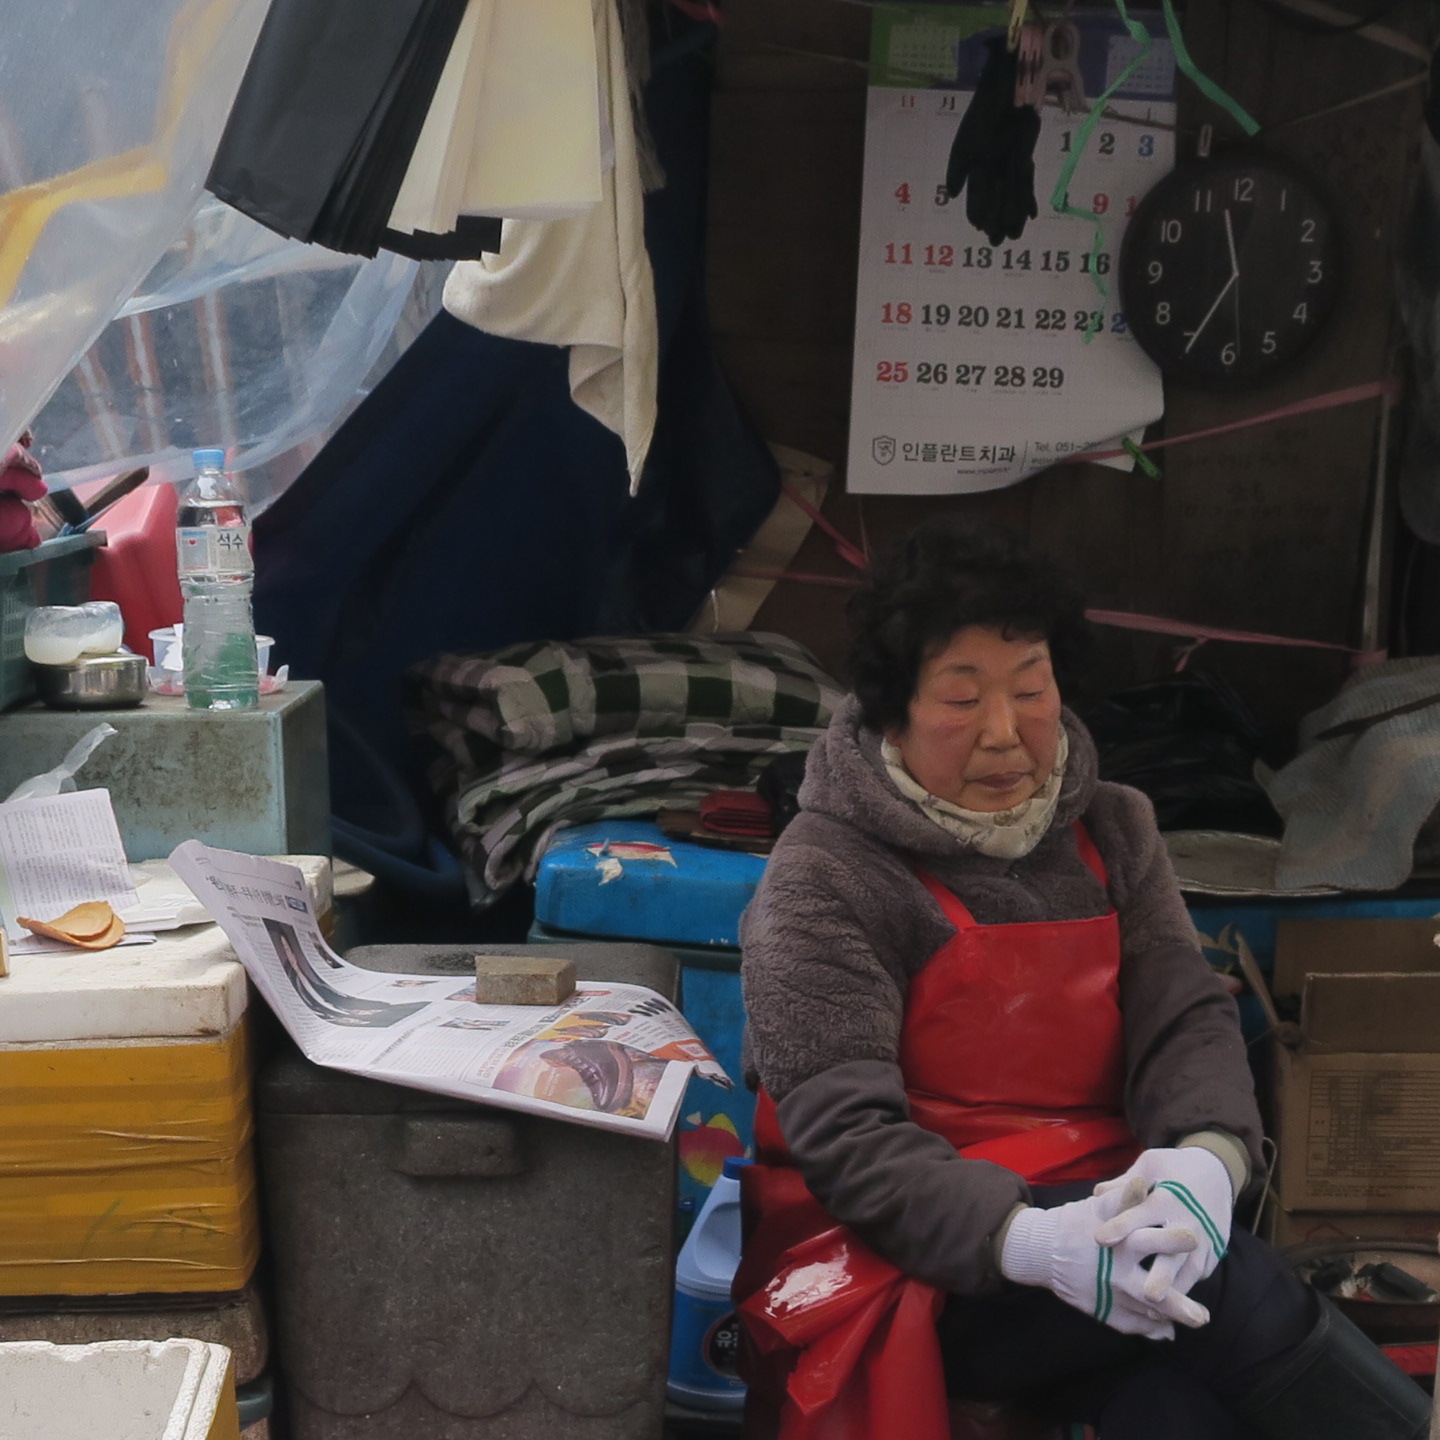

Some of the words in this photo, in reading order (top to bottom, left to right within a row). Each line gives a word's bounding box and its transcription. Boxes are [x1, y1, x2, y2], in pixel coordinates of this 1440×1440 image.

[1061, 131, 1072, 153] 1
[1098, 133, 1115, 155] 2
[1138, 134, 1155, 157] 3
[894, 182, 911, 205] 4
[934, 184, 950, 206] 5
[1195, 189, 1212, 213] 11
[1234, 177, 1255, 202] 12
[1092, 192, 1109, 215] 9
[1160, 219, 1183, 244] 10
[1300, 218, 1316, 243] 2
[884, 243, 913, 265] 11
[924, 244, 954, 267] 12
[961, 246, 993, 269] 13
[1001, 248, 1032, 271] 14
[1039, 250, 1070, 273] 15
[1078, 252, 1110, 275] 16
[1147, 260, 1164, 285] 9
[1307, 260, 1323, 284] 3
[880, 302, 913, 325] 18
[921, 303, 951, 326] 19
[957, 305, 990, 328] 20
[996, 307, 1025, 330] 21
[1034, 309, 1067, 331] 22
[1073, 310, 1104, 333] 23
[1155, 301, 1172, 326] 8
[1292, 301, 1309, 325] 4
[1220, 342, 1236, 366] 6
[1261, 330, 1277, 355] 5
[875, 360, 909, 383] 25
[915, 362, 948, 385] 26
[955, 363, 986, 386] 27
[993, 365, 1027, 388] 28
[1032, 366, 1065, 389] 29
[901, 440, 1017, 464] 인플란트치과
[216, 532, 244, 551] 석수
